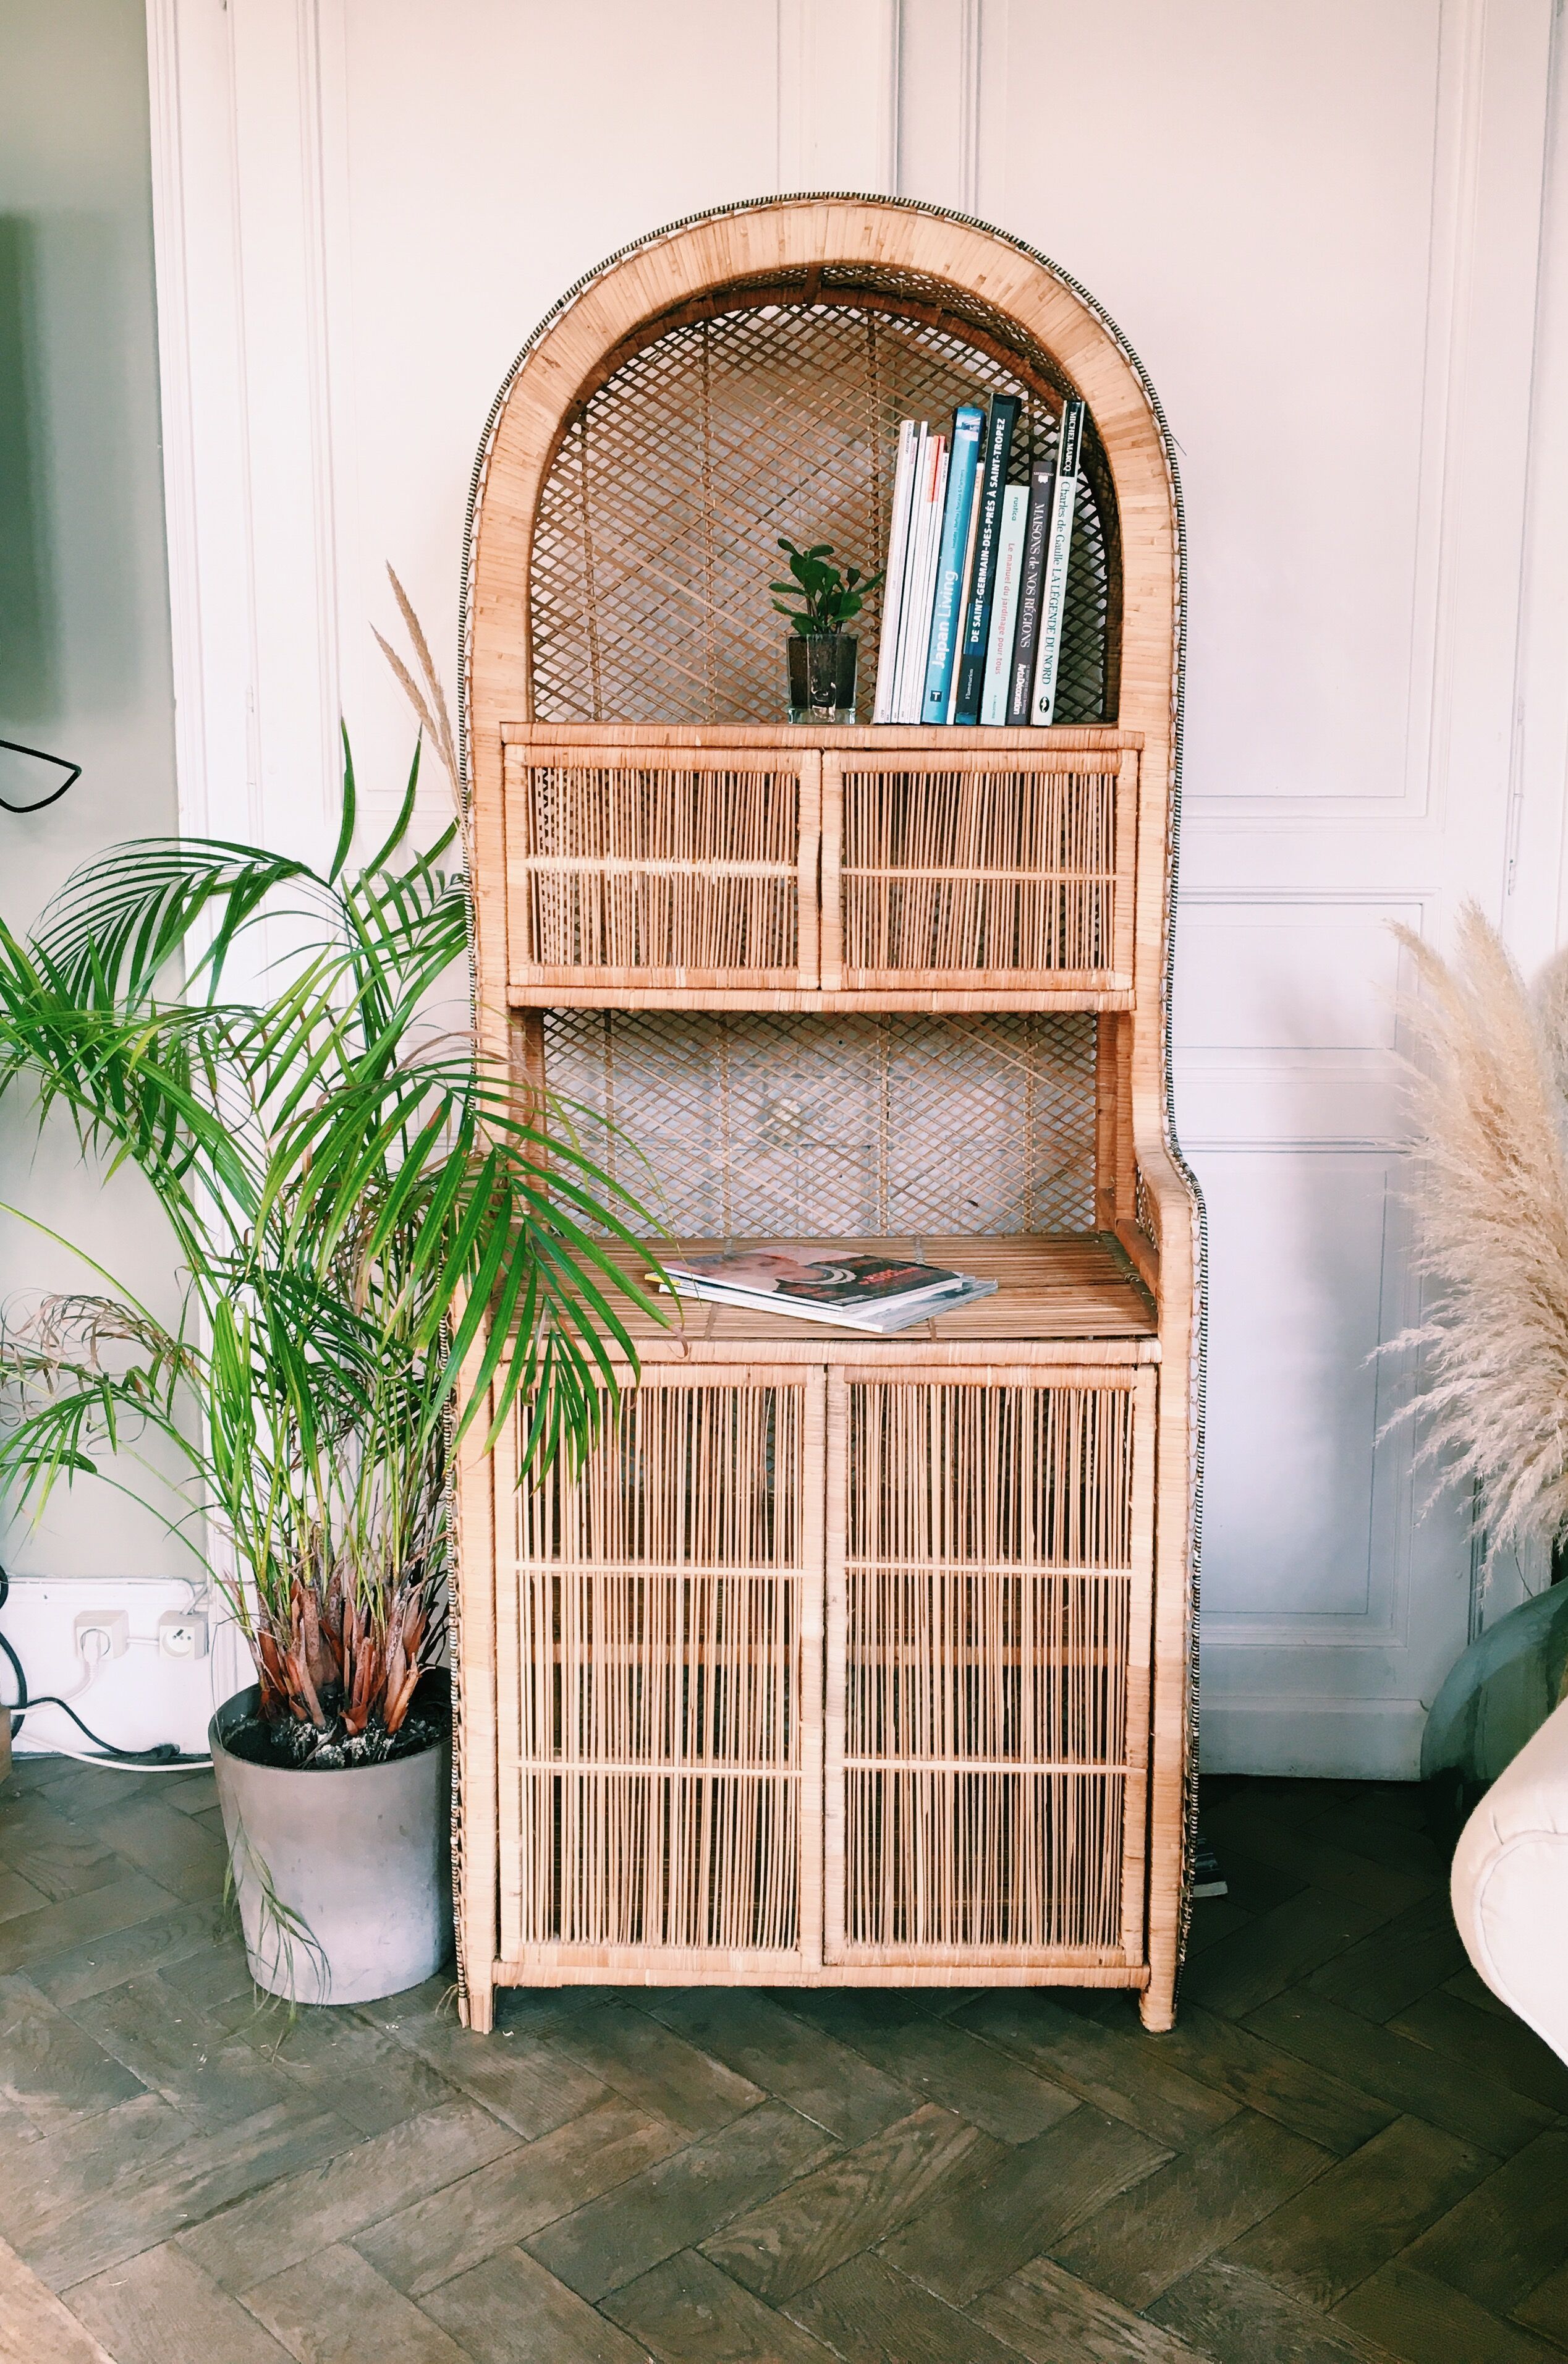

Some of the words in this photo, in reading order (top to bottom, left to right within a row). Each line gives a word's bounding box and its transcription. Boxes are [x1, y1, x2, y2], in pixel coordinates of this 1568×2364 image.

[1067, 411, 1077, 442] MICHEL
[990, 418, 1006, 488] SAINT-TROPEZ
[1063, 443, 1074, 472] MARCQ
[1057, 482, 1070, 517] Charles
[1030, 503, 1045, 556] MAISONS
[1057, 521, 1066, 531] de
[1007, 543, 1015, 551] Le
[1028, 556, 1040, 569] de
[1053, 534, 1065, 565] Gaulle
[975, 500, 996, 627] SAINT-GERMAIN-DES-PRÉS
[1004, 552, 1012, 583] manuel
[1051, 568, 1061, 582] LA
[937, 571, 958, 616] Living
[1004, 585, 1011, 594] du
[1024, 571, 1038, 597] NOS
[998, 595, 1009, 636] jardinage
[1020, 598, 1036, 648] RÉGIONS
[1046, 585, 1061, 634] LÉGENDE
[931, 622, 949, 670] Japan
[971, 633, 980, 642] DE
[996, 638, 1004, 656] pour
[1044, 636, 1054, 652] DU
[965, 668, 973, 699] Flammarion
[1043, 654, 1053, 684] NORD
